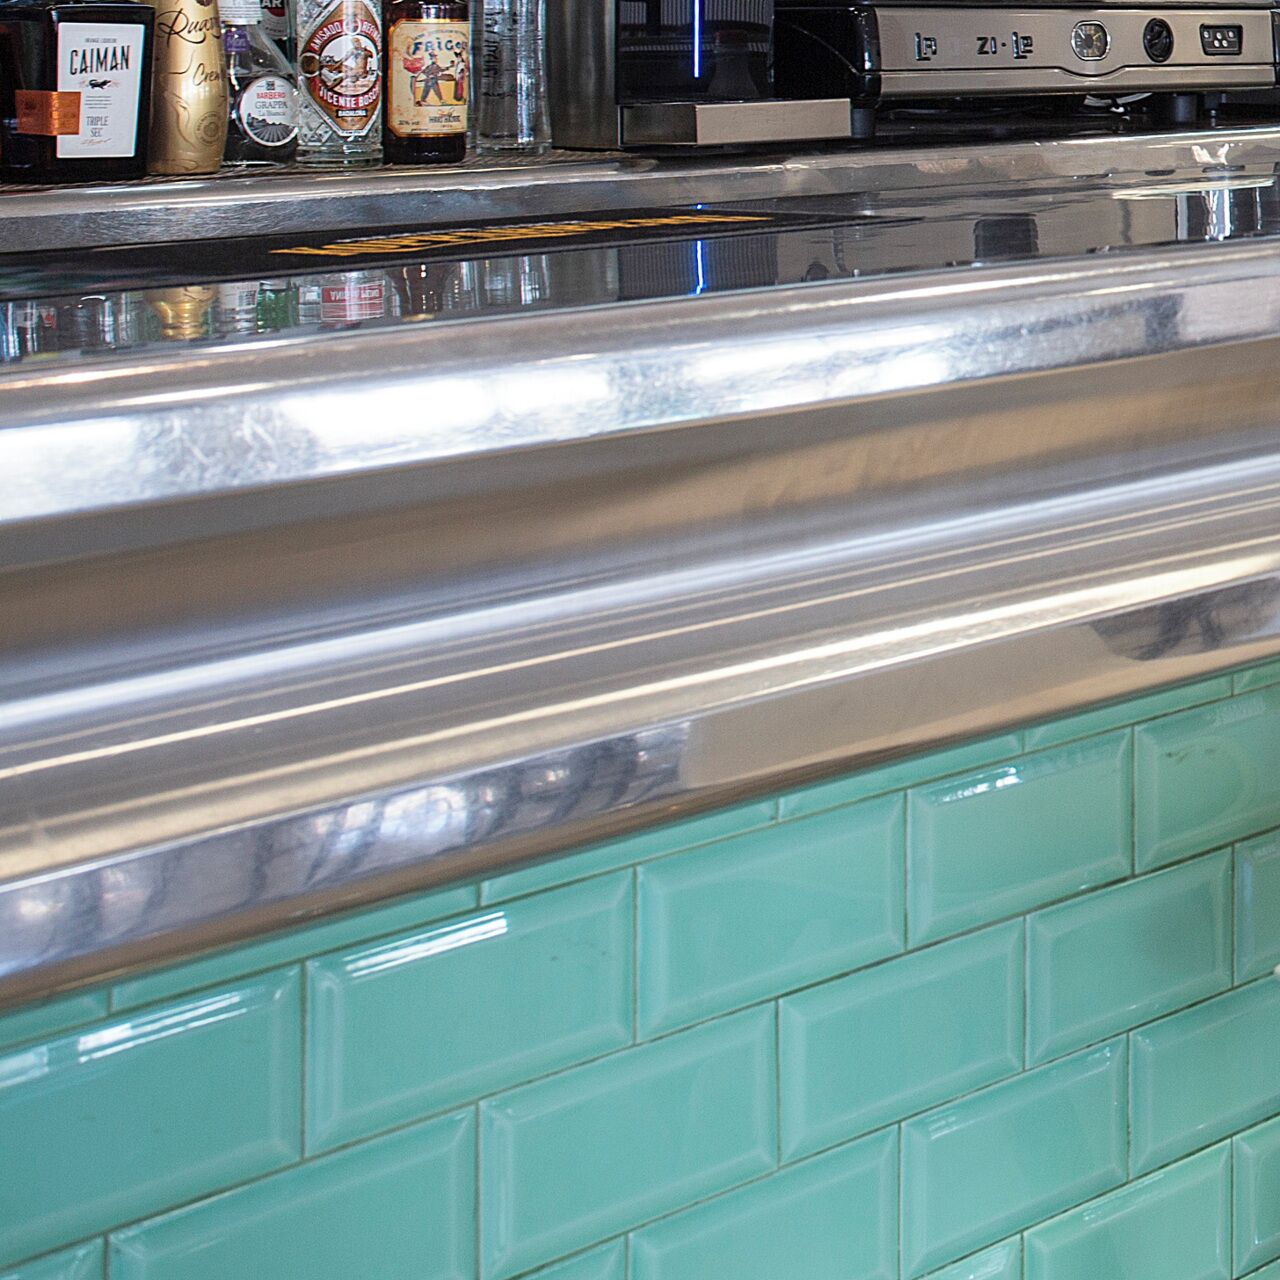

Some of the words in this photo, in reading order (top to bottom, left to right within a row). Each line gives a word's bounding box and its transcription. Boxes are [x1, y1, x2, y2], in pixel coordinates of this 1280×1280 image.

[70, 44, 131, 76] CAIMAN
[255, 101, 288, 109] GRAPPA
[86, 116, 110, 127] TRIPLE
